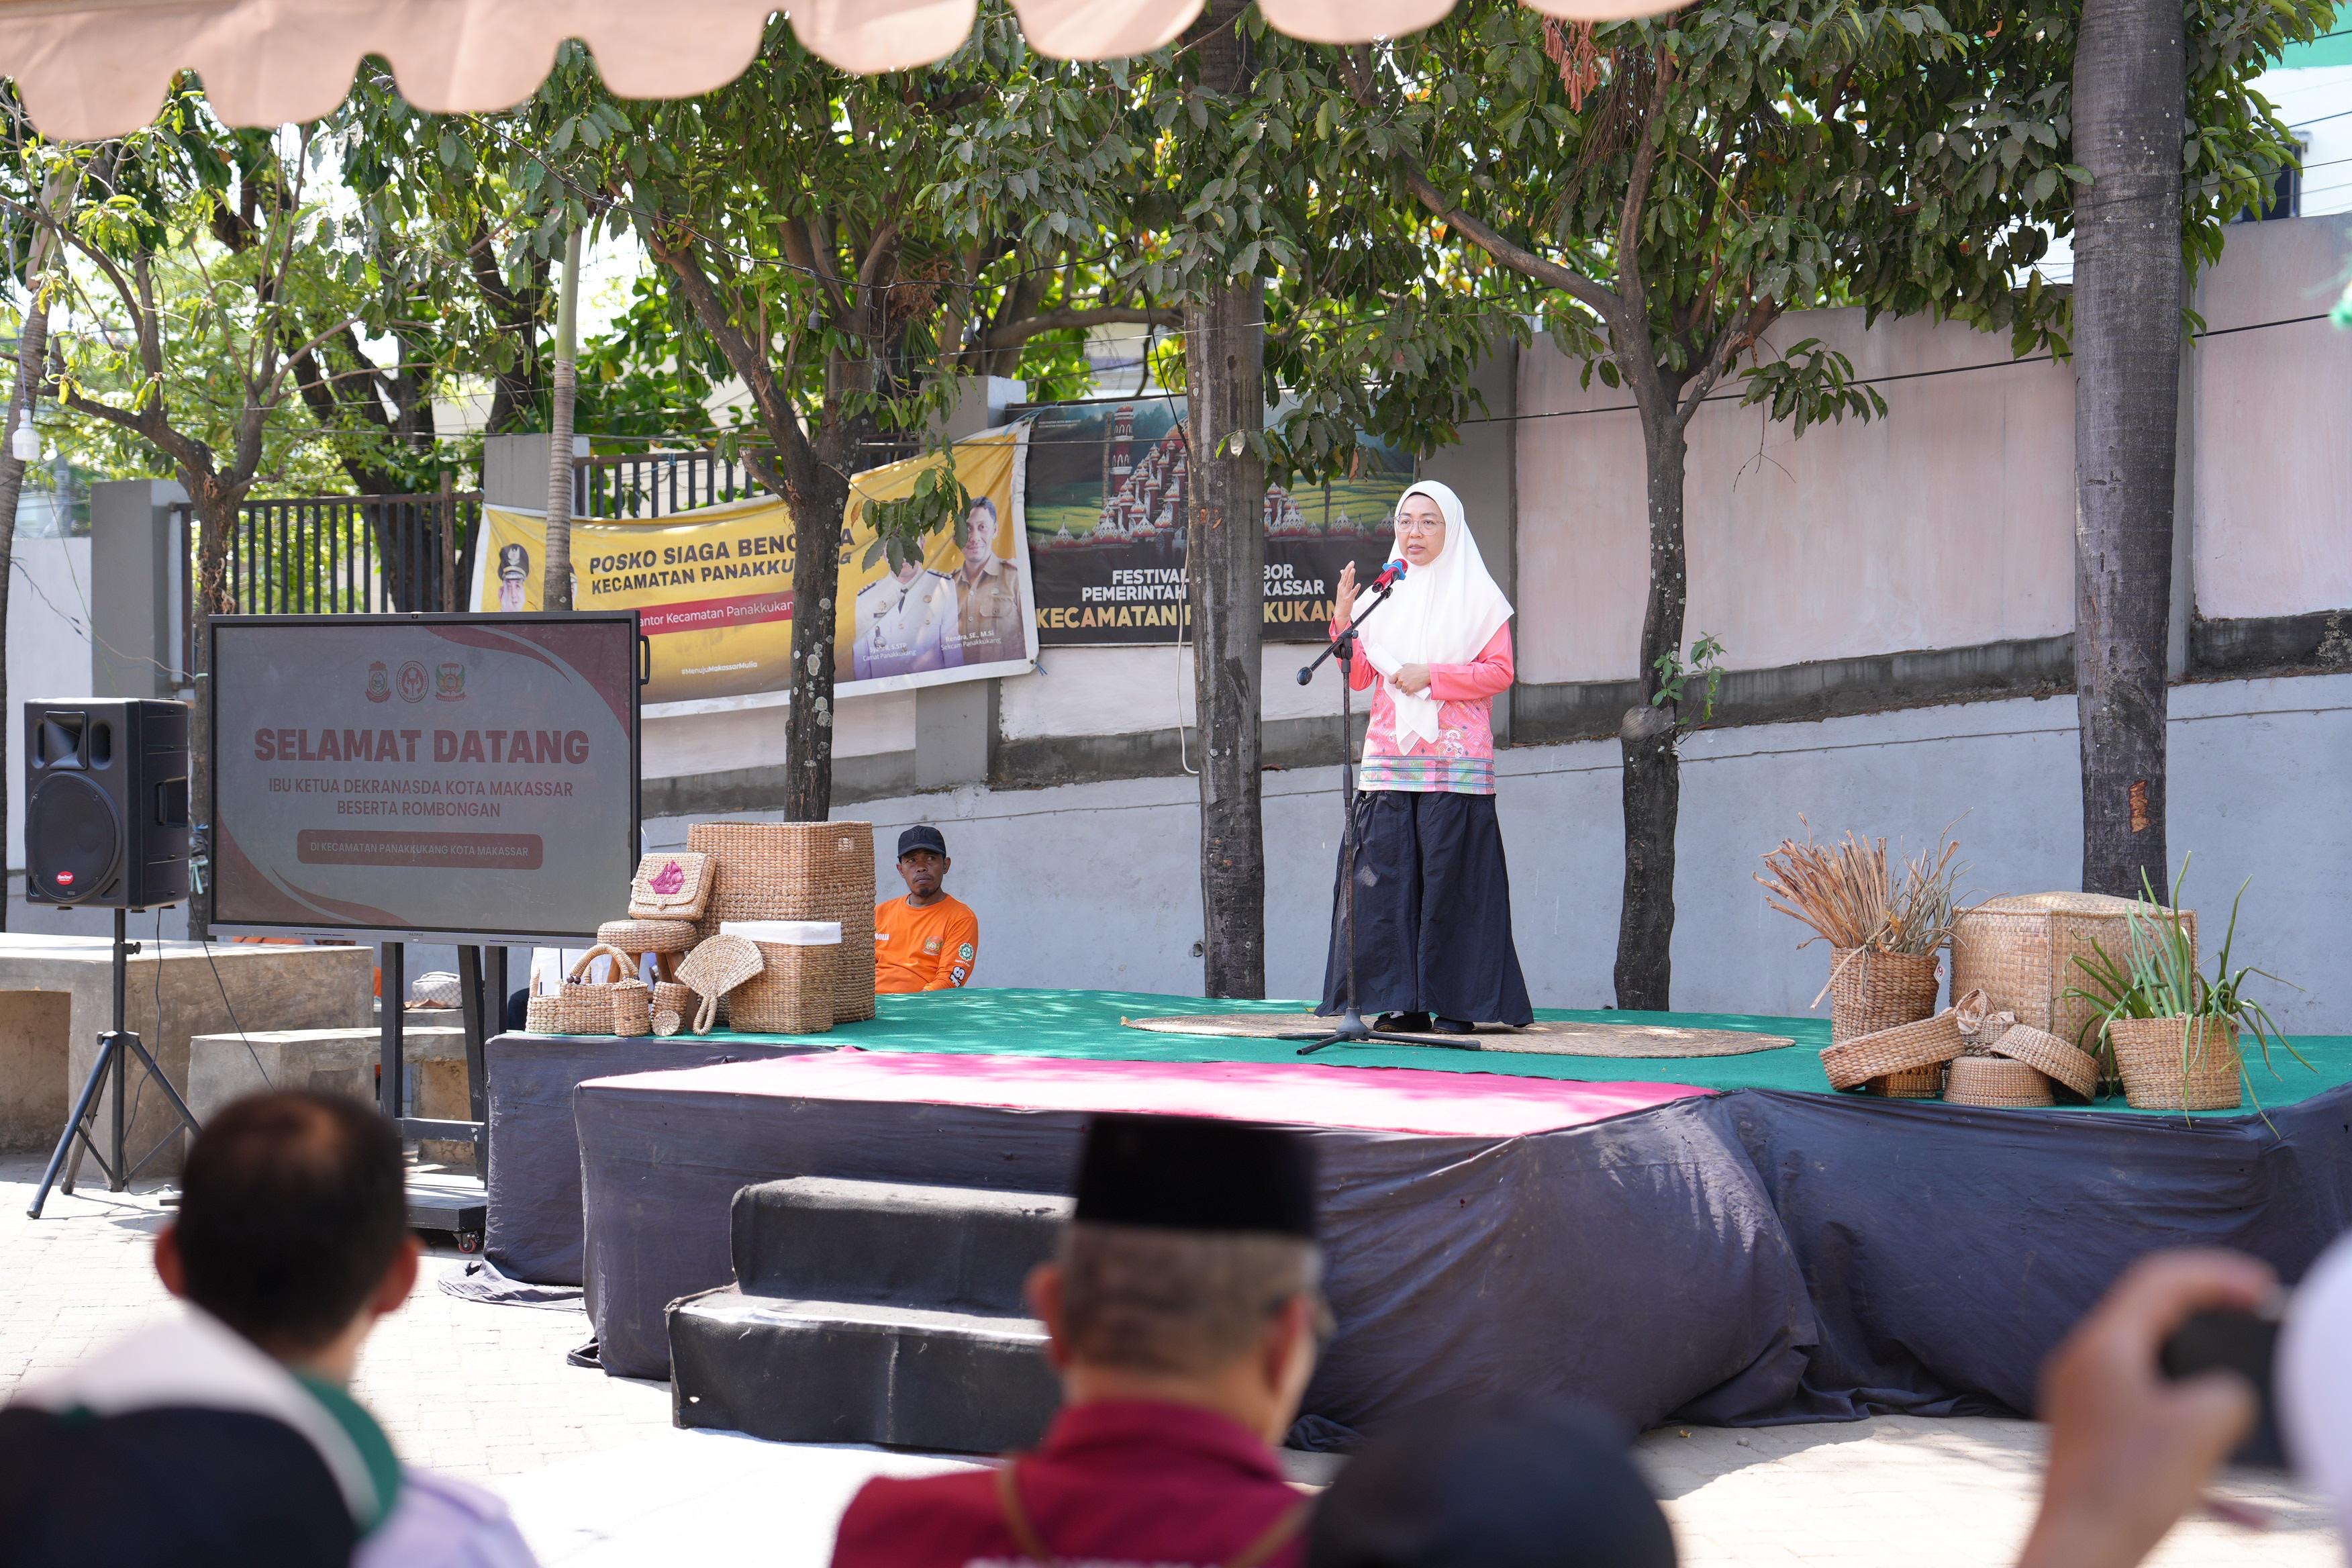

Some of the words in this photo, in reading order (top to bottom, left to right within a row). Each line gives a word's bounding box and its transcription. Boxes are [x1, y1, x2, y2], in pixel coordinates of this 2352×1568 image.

[589, 550, 656, 574] POSKO
[663, 542, 730, 565] SIAGA
[592, 569, 695, 595] KECAMATAN
[1112, 569, 1189, 585] FESTIVAL
[1263, 564, 1294, 579] BOR
[1082, 585, 1187, 601] PEMERINTAH
[1263, 579, 1325, 596] KASSAR
[640, 616, 663, 627] antor
[667, 609, 724, 624] Kecamatan
[727, 601, 793, 618] Panakkukan
[1036, 605, 1177, 628] KECAMATAN
[681, 660, 758, 675] #MenujuMakassarMulia
[254, 728, 422, 763] SELAMAT
[434, 730, 589, 764] DATANG
[268, 778, 291, 793] IBU
[295, 778, 340, 793] KETUA
[344, 779, 442, 795] DEKRANASDA
[446, 781, 486, 795] KOTA
[490, 781, 573, 797] MAKASSAR
[337, 800, 398, 815] BESERTA
[403, 801, 500, 817] ROMBONGAN
[311, 842, 320, 852] DI
[322, 842, 377, 852] KECAMATAN
[379, 844, 448, 854] PANAKKUKANG
[450, 844, 475, 855] KOTA
[477, 846, 529, 856] MAKASSAR
